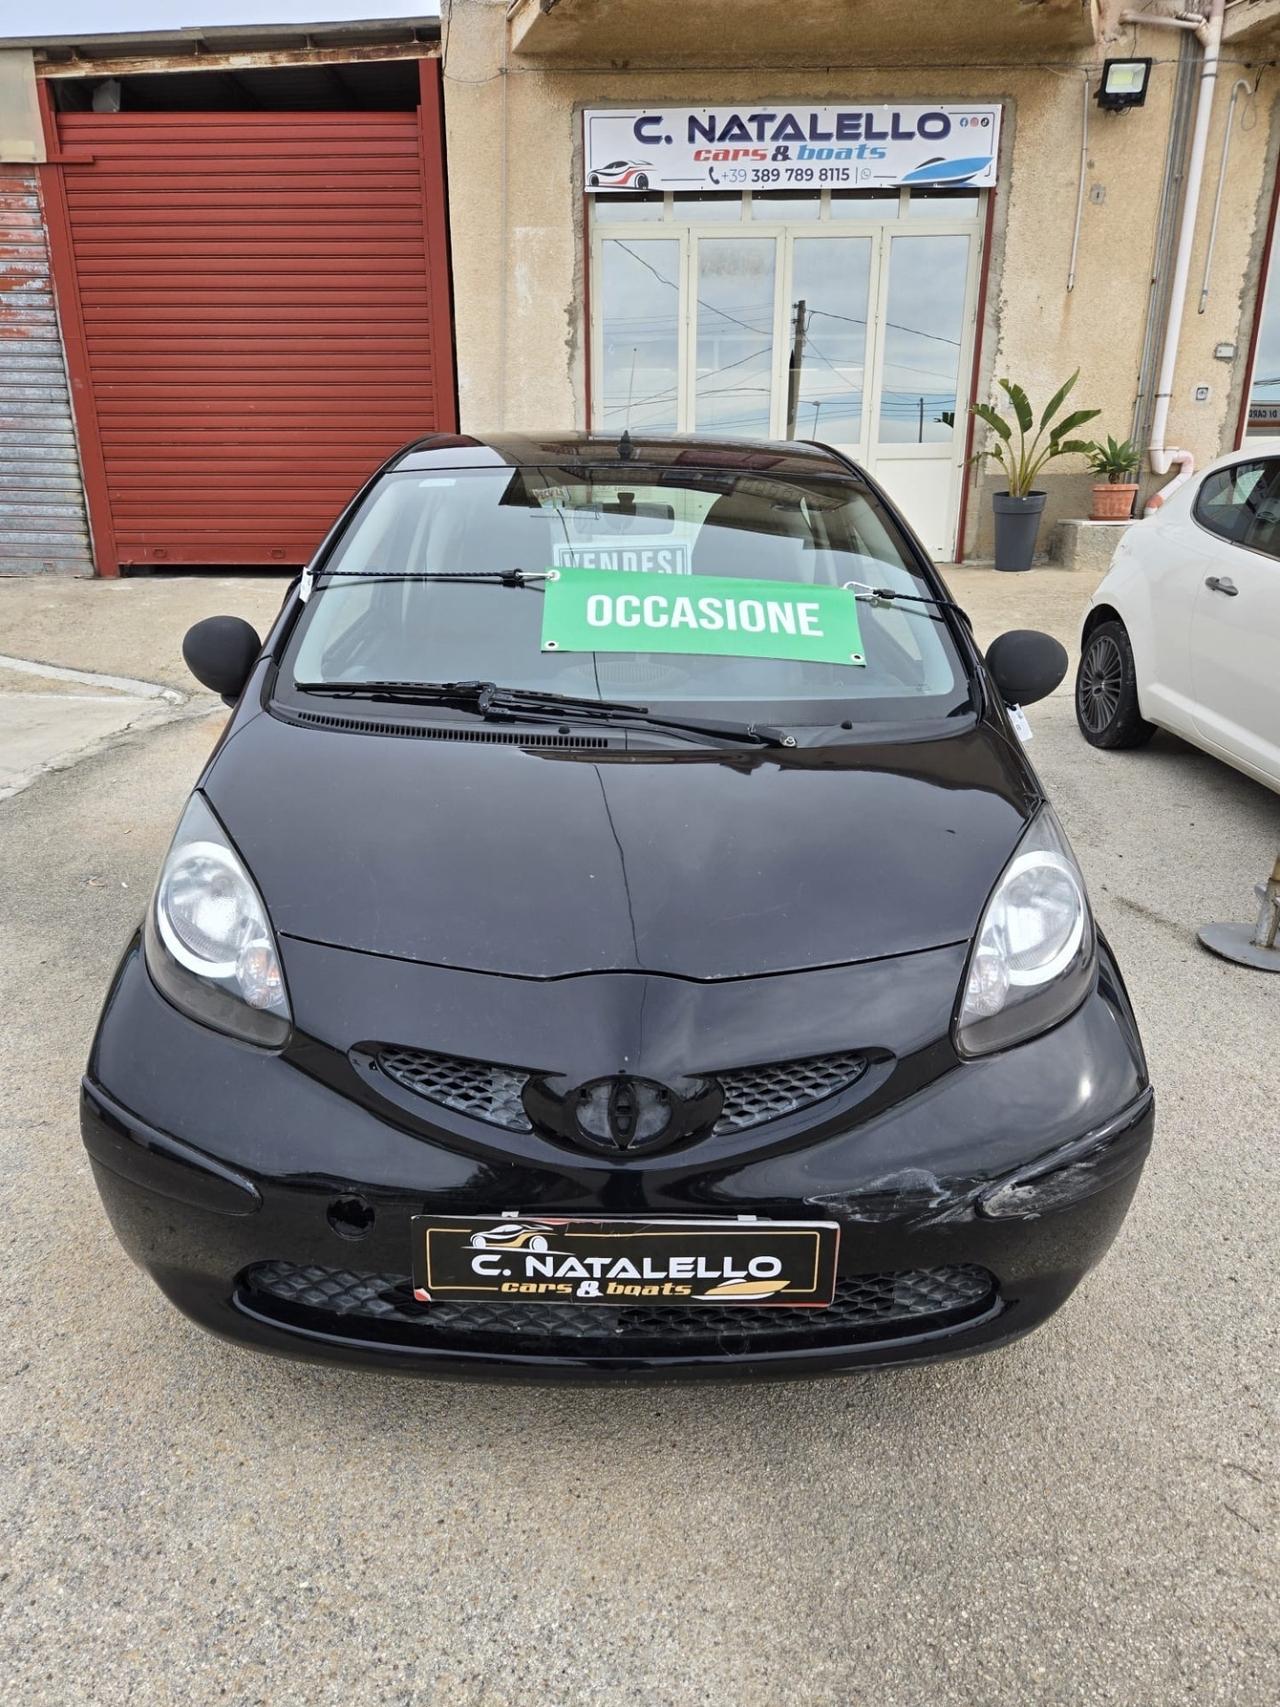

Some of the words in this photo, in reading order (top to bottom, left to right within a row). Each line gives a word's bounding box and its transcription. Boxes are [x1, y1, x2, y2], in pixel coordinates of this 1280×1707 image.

[633, 115, 673, 145] C.
[687, 111, 951, 144] NATALELLO
[721, 168, 747, 183] +39
[751, 168, 780, 182] 389
[785, 168, 814, 182] 789
[818, 167, 850, 182] 8115
[586, 594, 824, 637] OCCASIONE
[471, 1254, 512, 1277] C.
[525, 1255, 782, 1278] NATALELLO
[501, 1282, 573, 1294] cars
